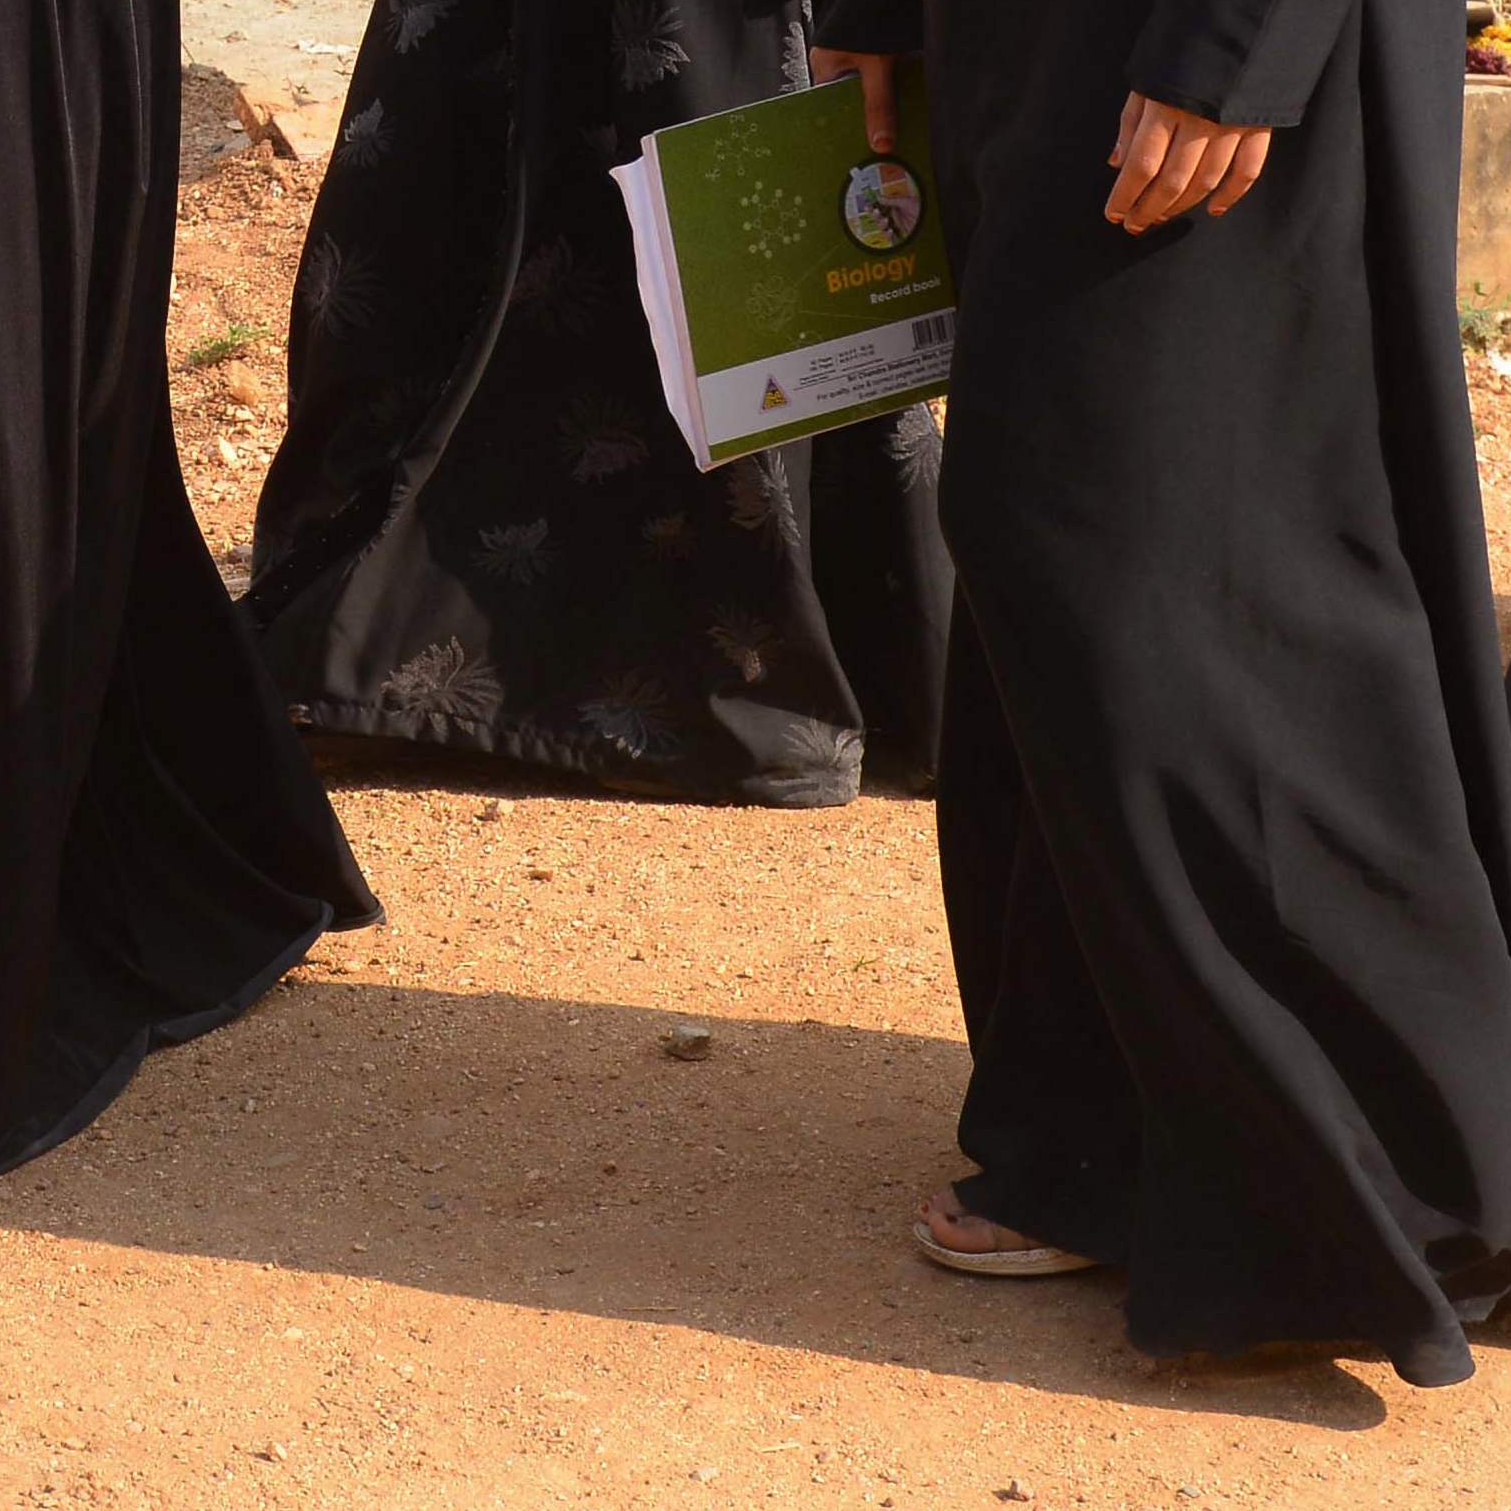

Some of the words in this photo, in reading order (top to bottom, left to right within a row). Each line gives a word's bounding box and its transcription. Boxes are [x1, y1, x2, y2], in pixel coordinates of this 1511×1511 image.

[826, 253, 917, 294] Biology
[869, 284, 911, 304] Record
[913, 276, 941, 292] book
